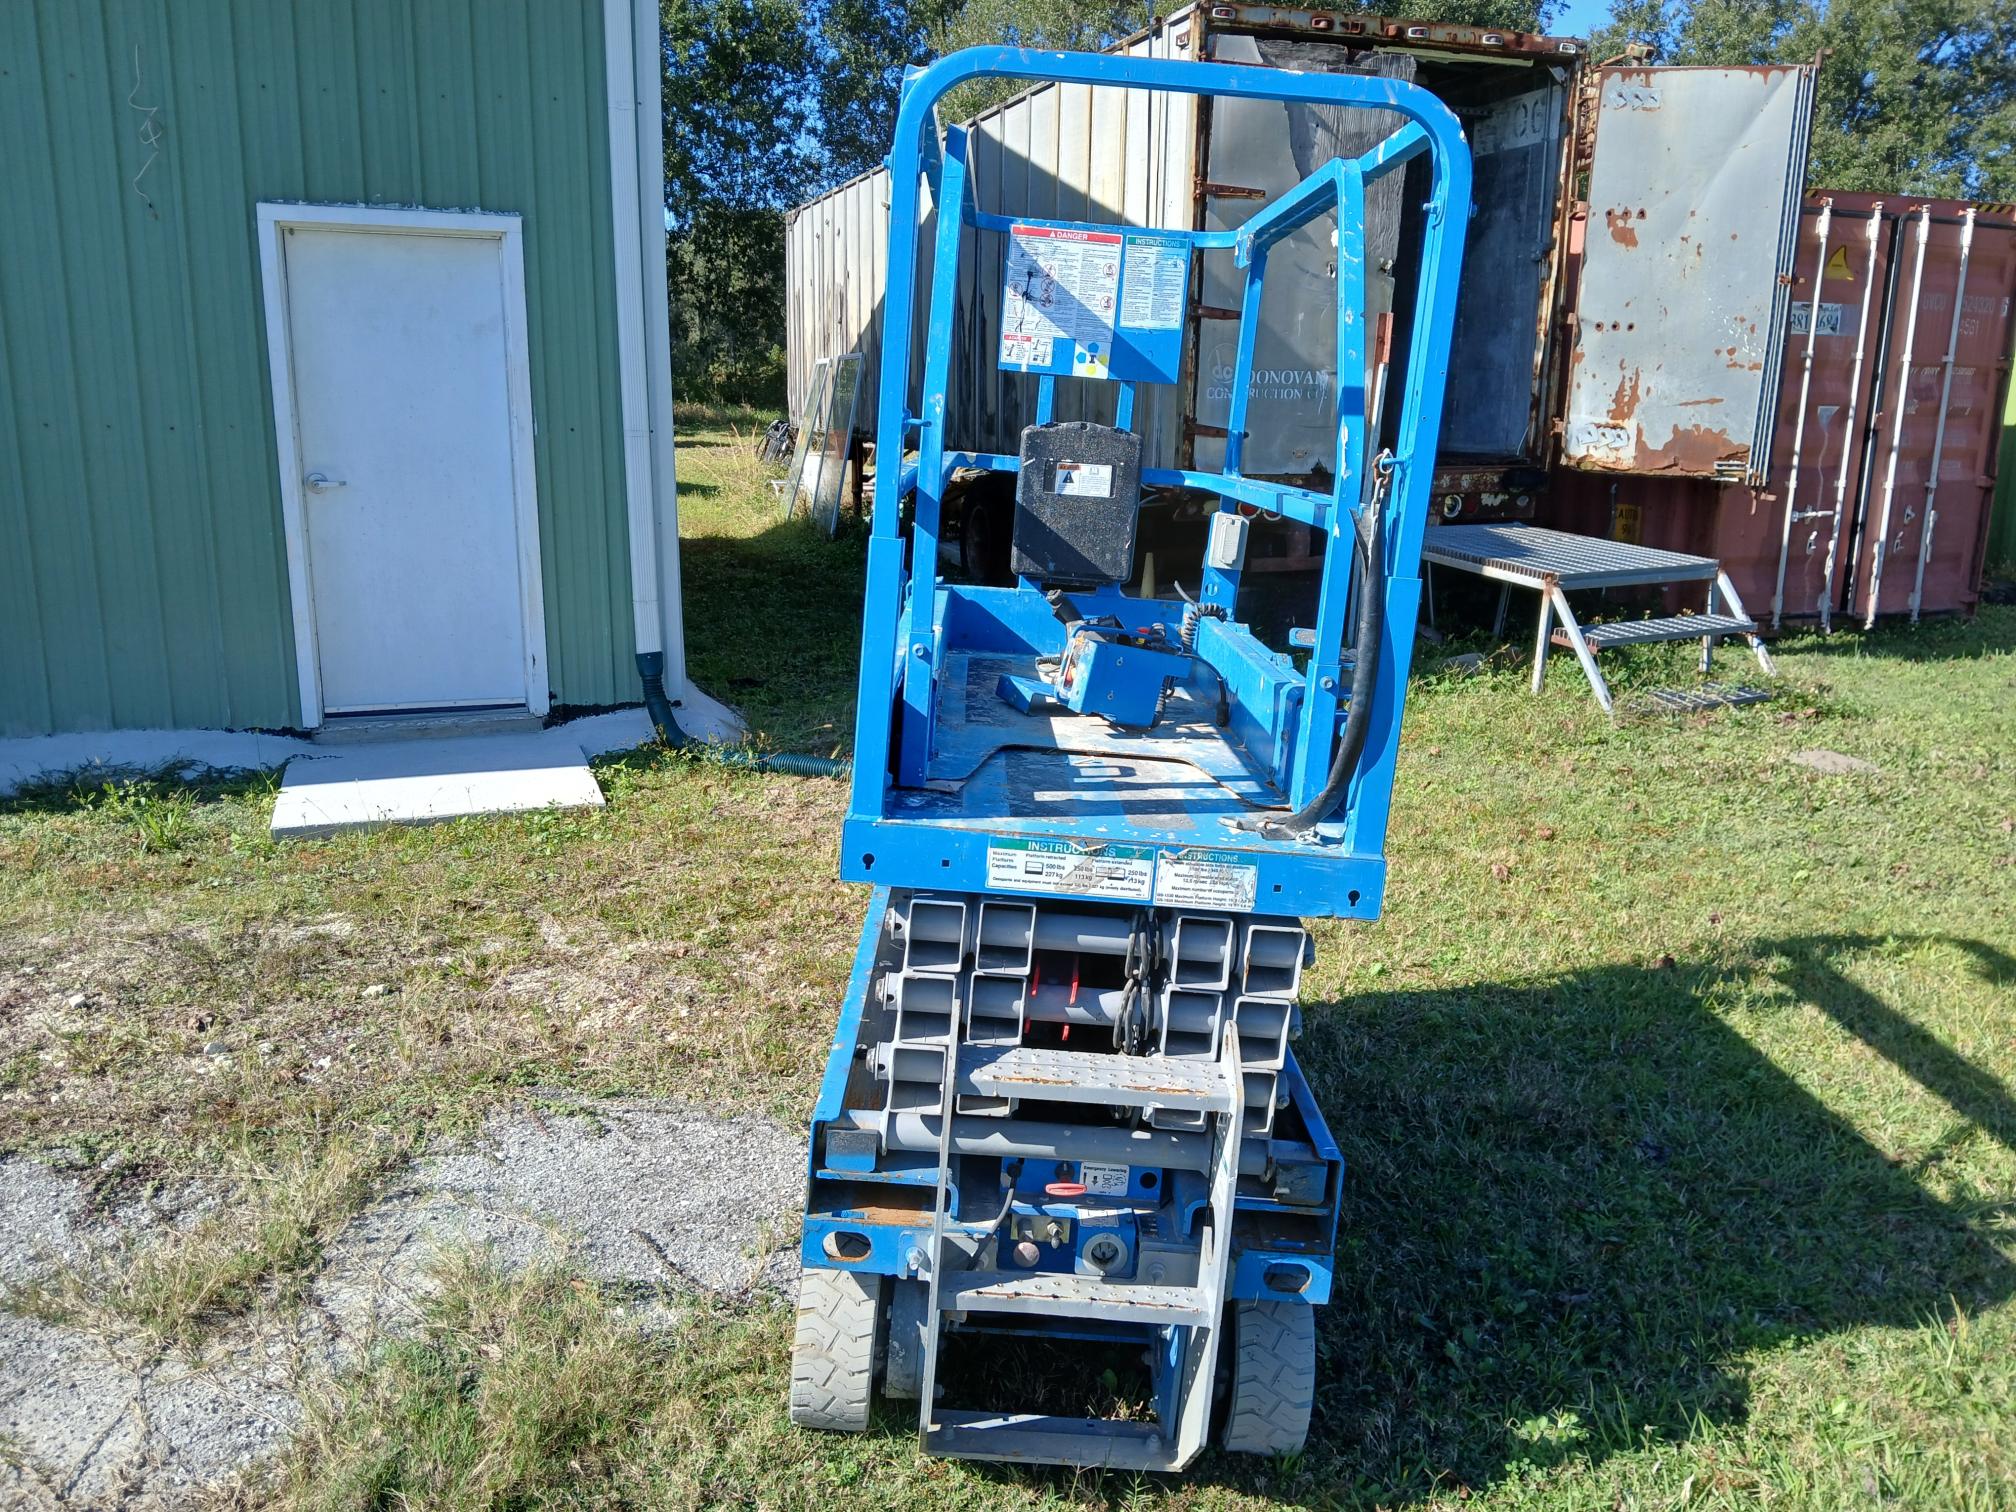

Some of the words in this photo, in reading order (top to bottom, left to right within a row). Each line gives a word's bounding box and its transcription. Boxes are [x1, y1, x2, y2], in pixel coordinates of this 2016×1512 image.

[1056, 231, 1088, 241] DANGER
[1135, 238, 1181, 248] INSTRUCTIONS
[1206, 387, 1302, 400] CONRUCTION
[1177, 852, 1239, 862] STRUCTIONS
[1138, 878, 1145, 886] kg
